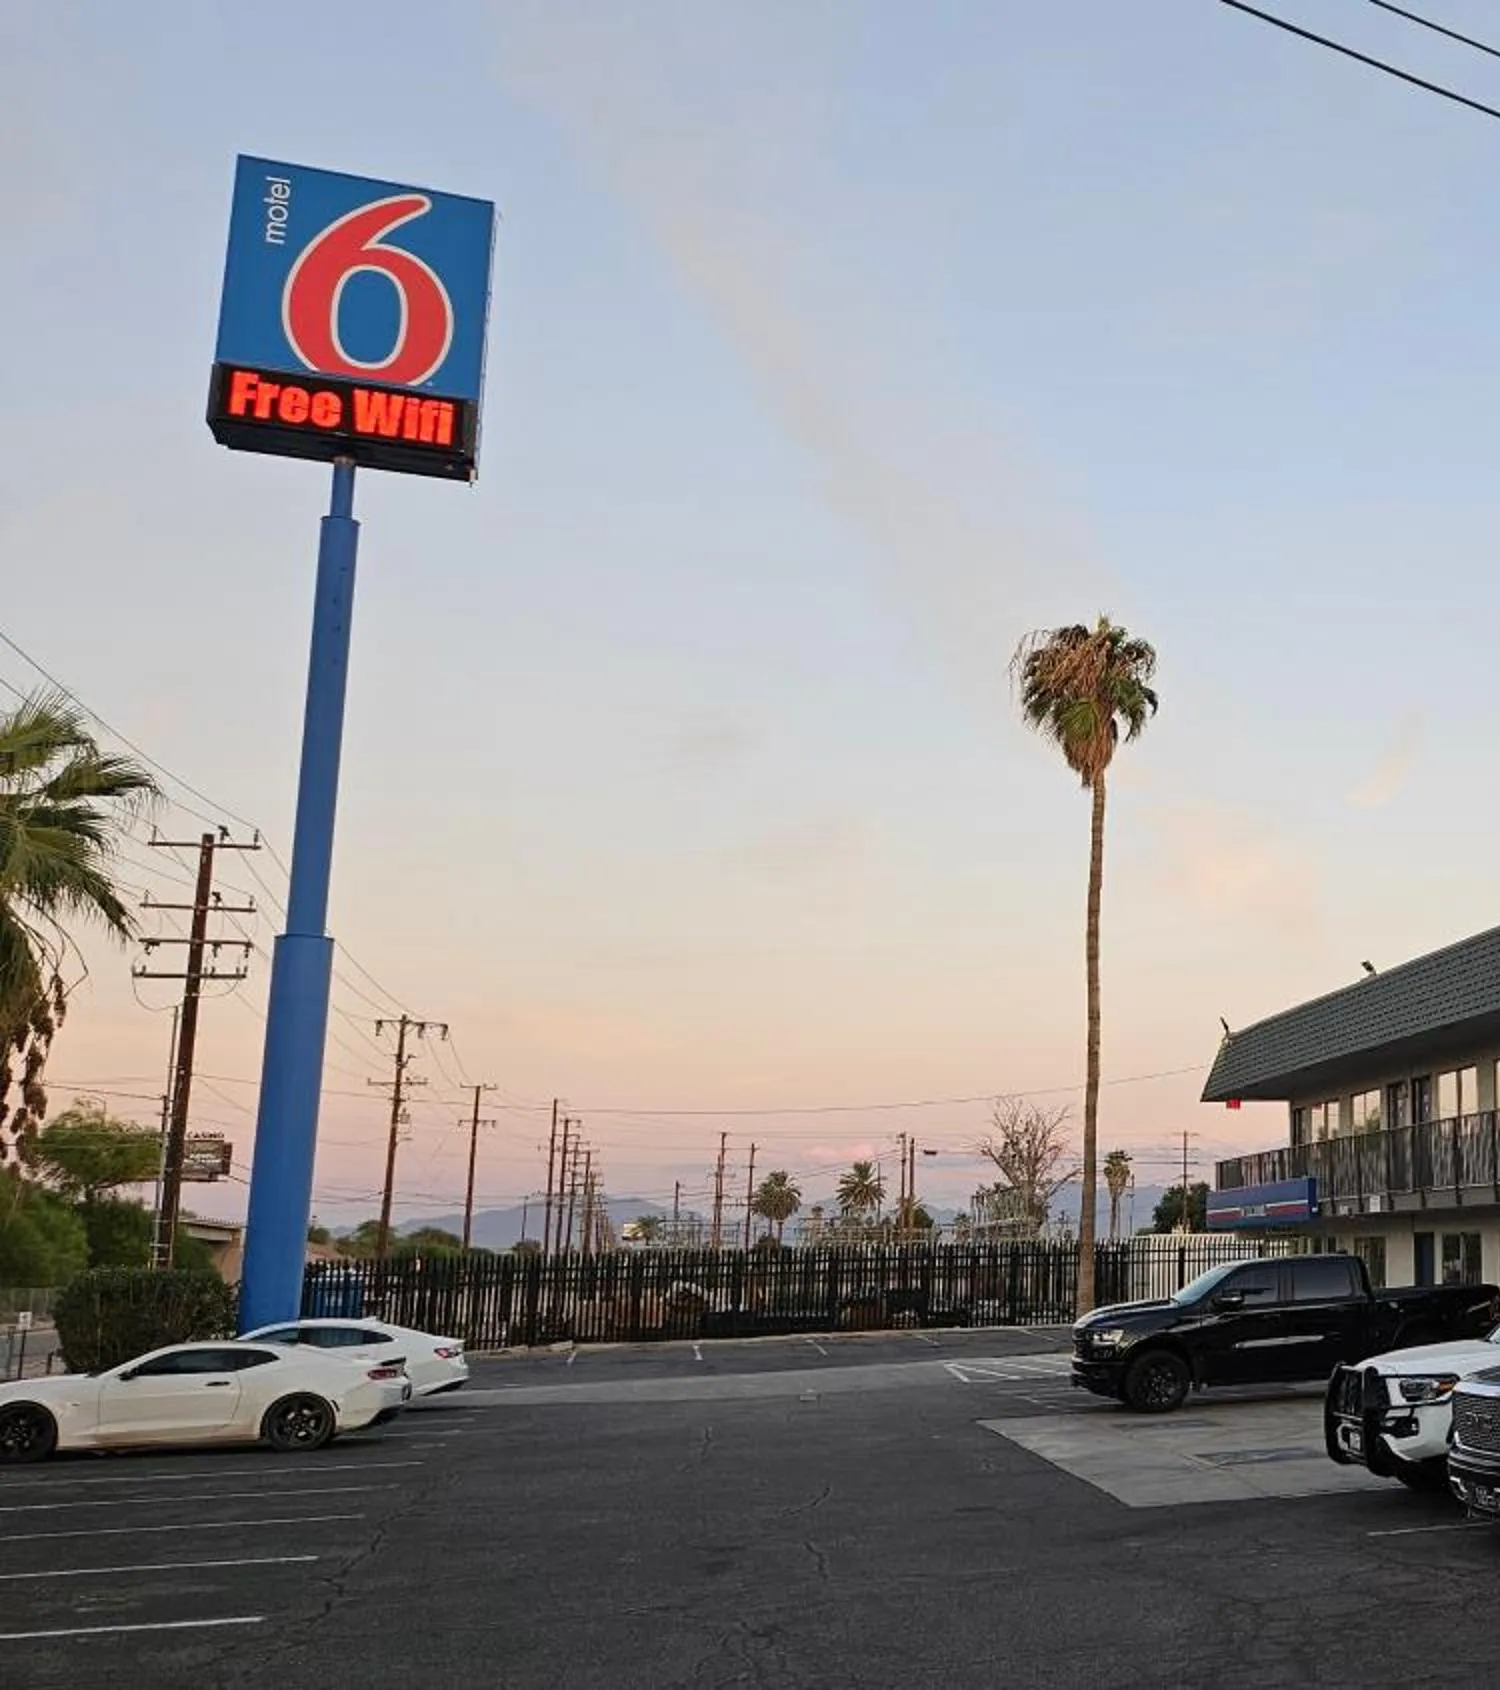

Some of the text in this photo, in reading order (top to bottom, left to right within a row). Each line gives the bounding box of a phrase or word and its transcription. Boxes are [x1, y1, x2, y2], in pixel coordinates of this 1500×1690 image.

[263, 176, 291, 244] motel
[282, 194, 454, 386] 6
[229, 371, 454, 445] Free Wifi
